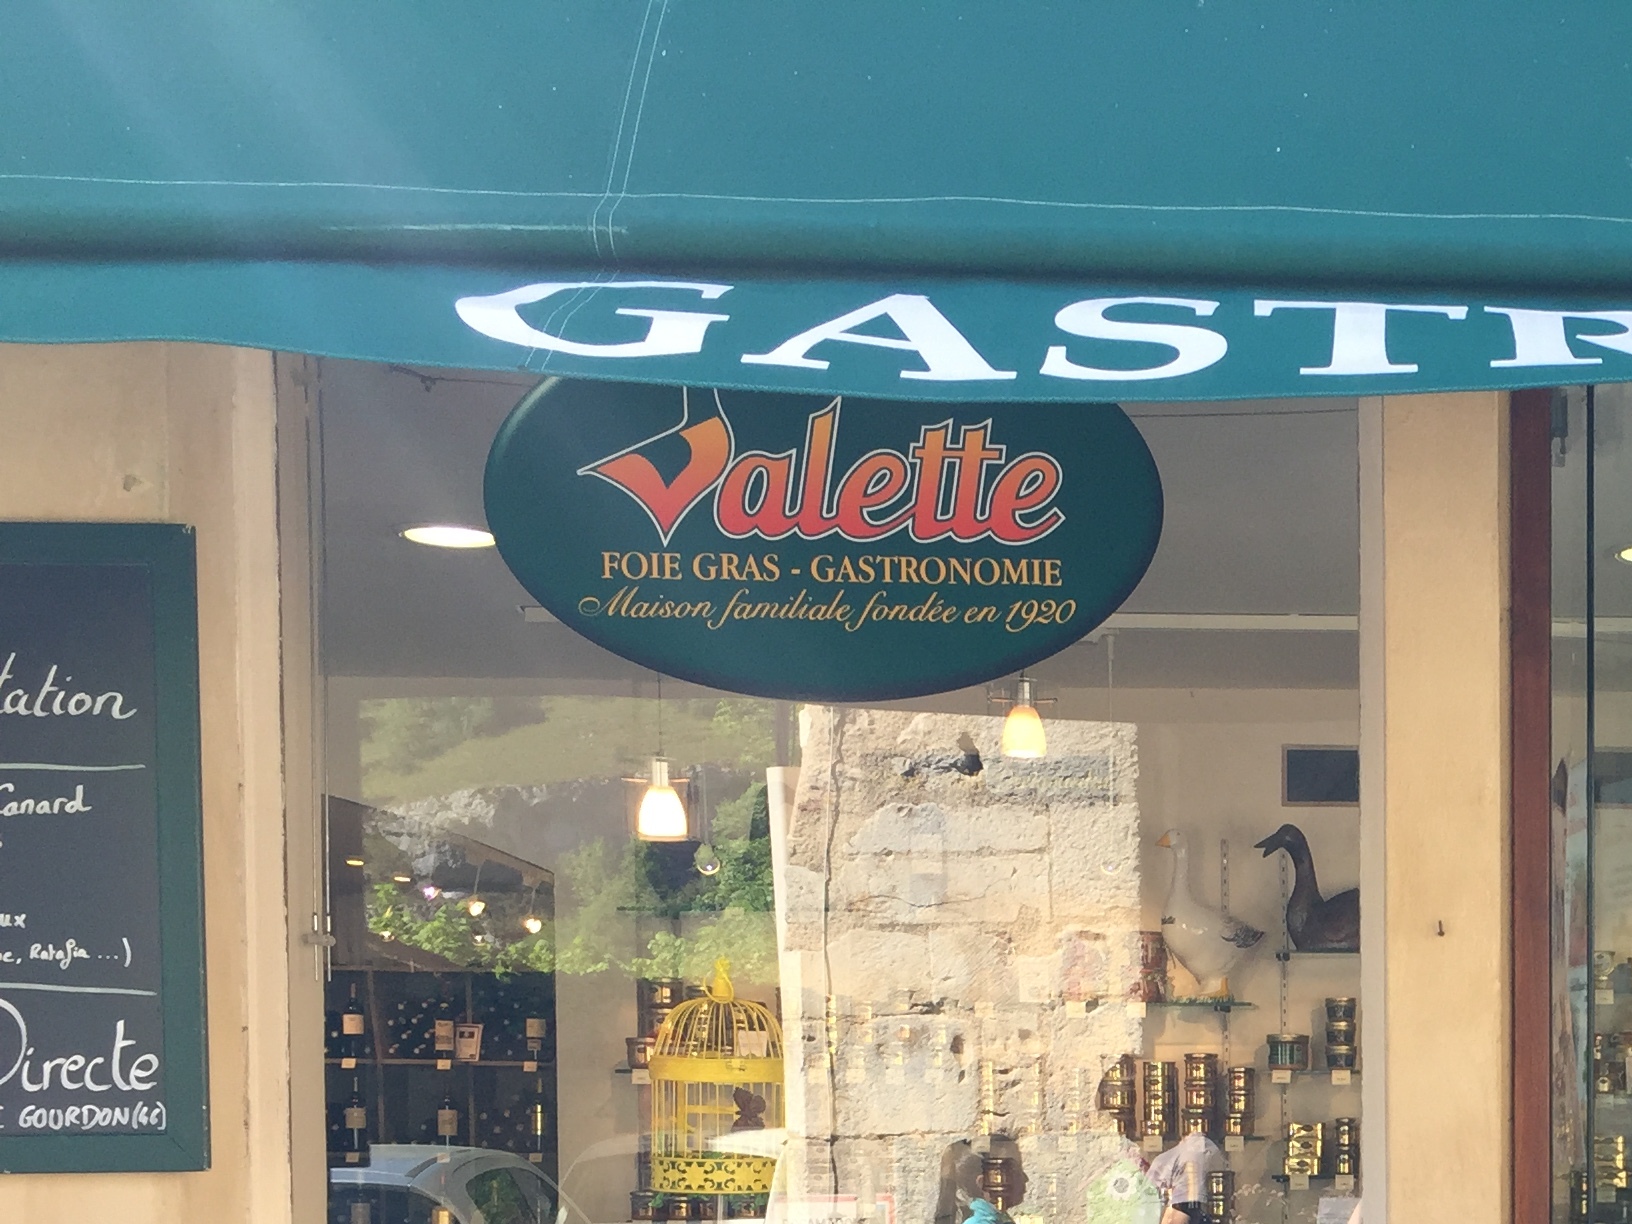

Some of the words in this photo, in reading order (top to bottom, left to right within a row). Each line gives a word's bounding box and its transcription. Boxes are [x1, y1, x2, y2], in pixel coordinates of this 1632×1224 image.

[577, 390, 1065, 546] Valette
[600, 551, 683, 580] FOIE
[692, 553, 782, 582] GRAS
[810, 554, 1063, 587] GASTRONOMIE
[578, 585, 716, 620] Maison
[707, 587, 853, 631] familiale
[844, 591, 958, 632] fondée
[963, 608, 1002, 624] en
[1005, 598, 1077, 633] 1920
